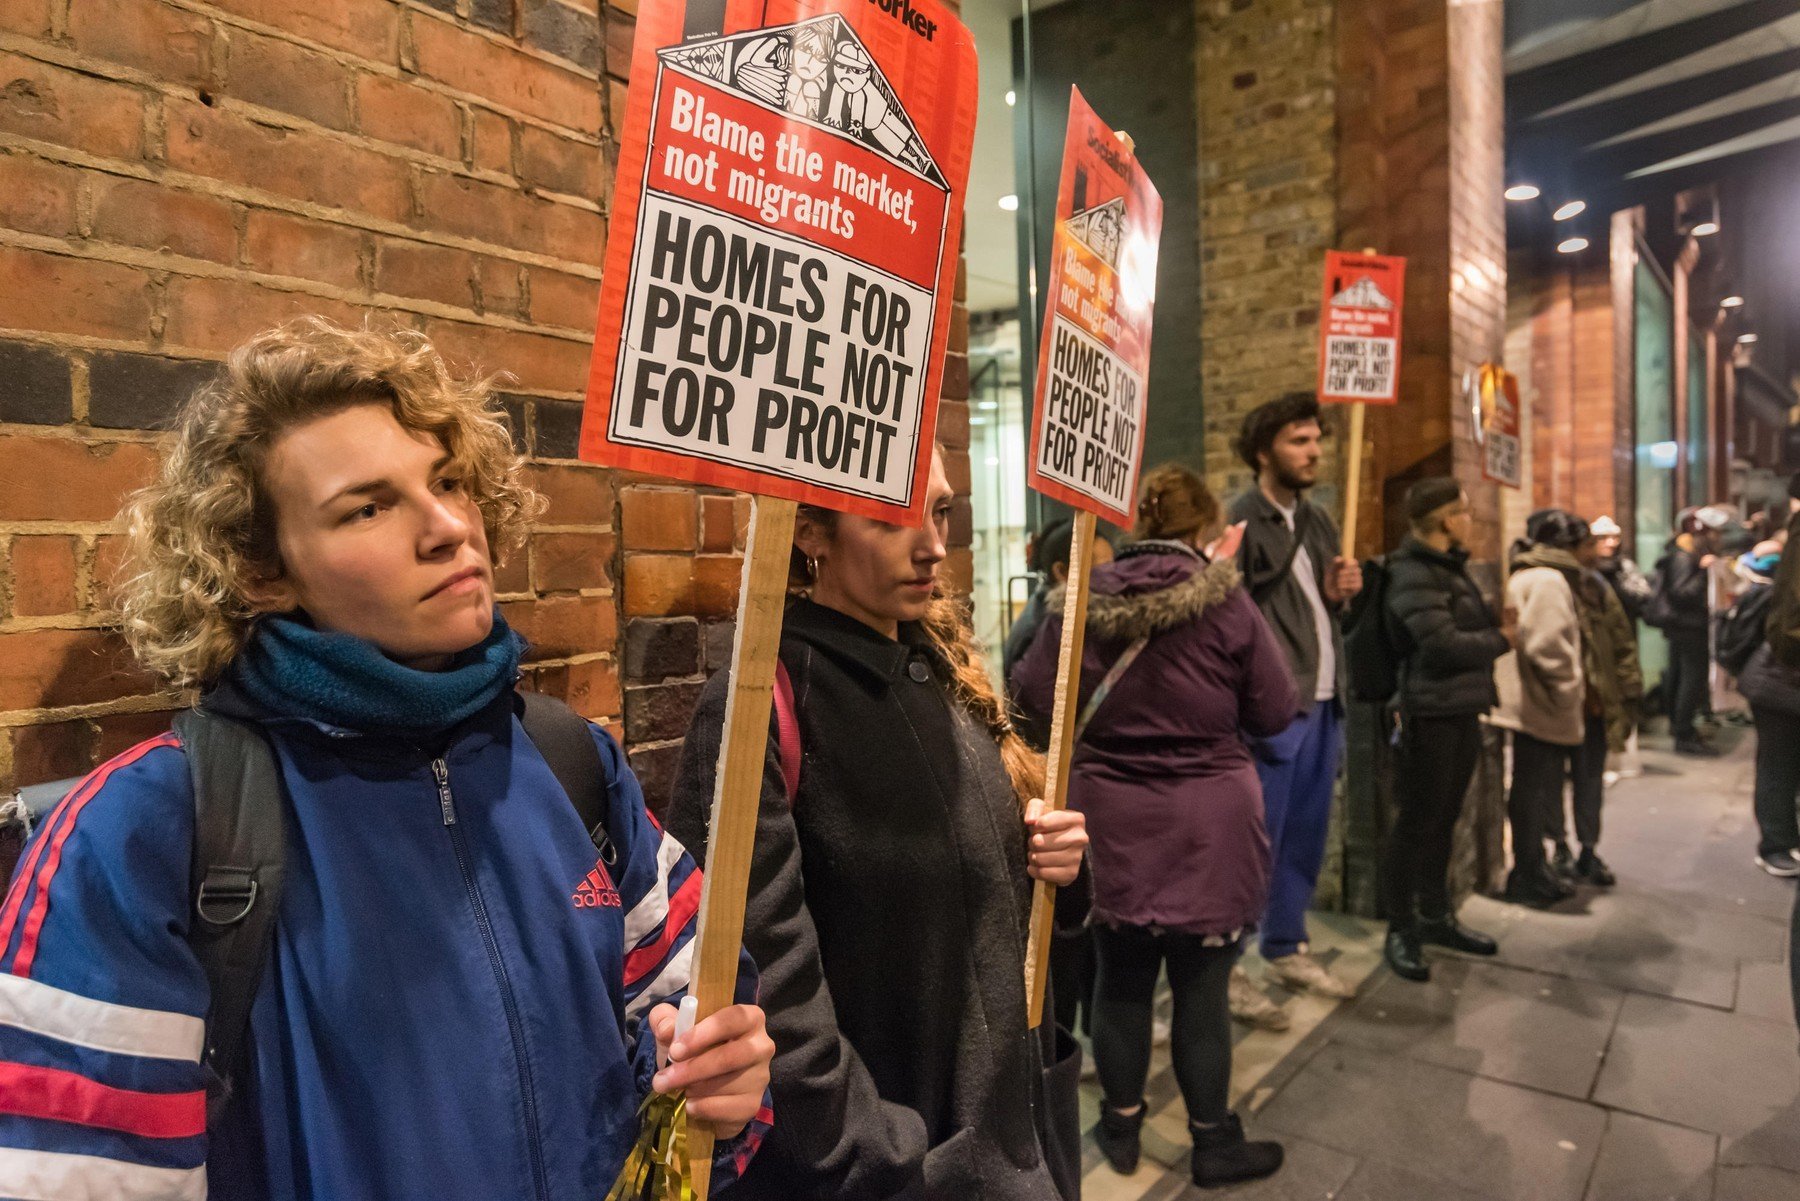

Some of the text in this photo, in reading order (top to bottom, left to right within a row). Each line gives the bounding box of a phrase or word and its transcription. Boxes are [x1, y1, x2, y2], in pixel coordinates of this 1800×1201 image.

[868, 0, 937, 42] orker
[663, 144, 855, 240] not migrants
[670, 86, 918, 233] Blame the market,
[650, 210, 911, 357] HOMES FOR
[1061, 283, 1079, 314] not
[1065, 245, 1095, 293] Blame
[640, 284, 913, 423] PEOPLE NOT
[1054, 326, 1136, 418] HOMES FOR
[629, 358, 897, 484] FOR PROFIT
[1043, 421, 1129, 501] FOR PROFIT
[1048, 373, 1136, 461] PEOPLE NOT
[572, 889, 621, 908] adidas
